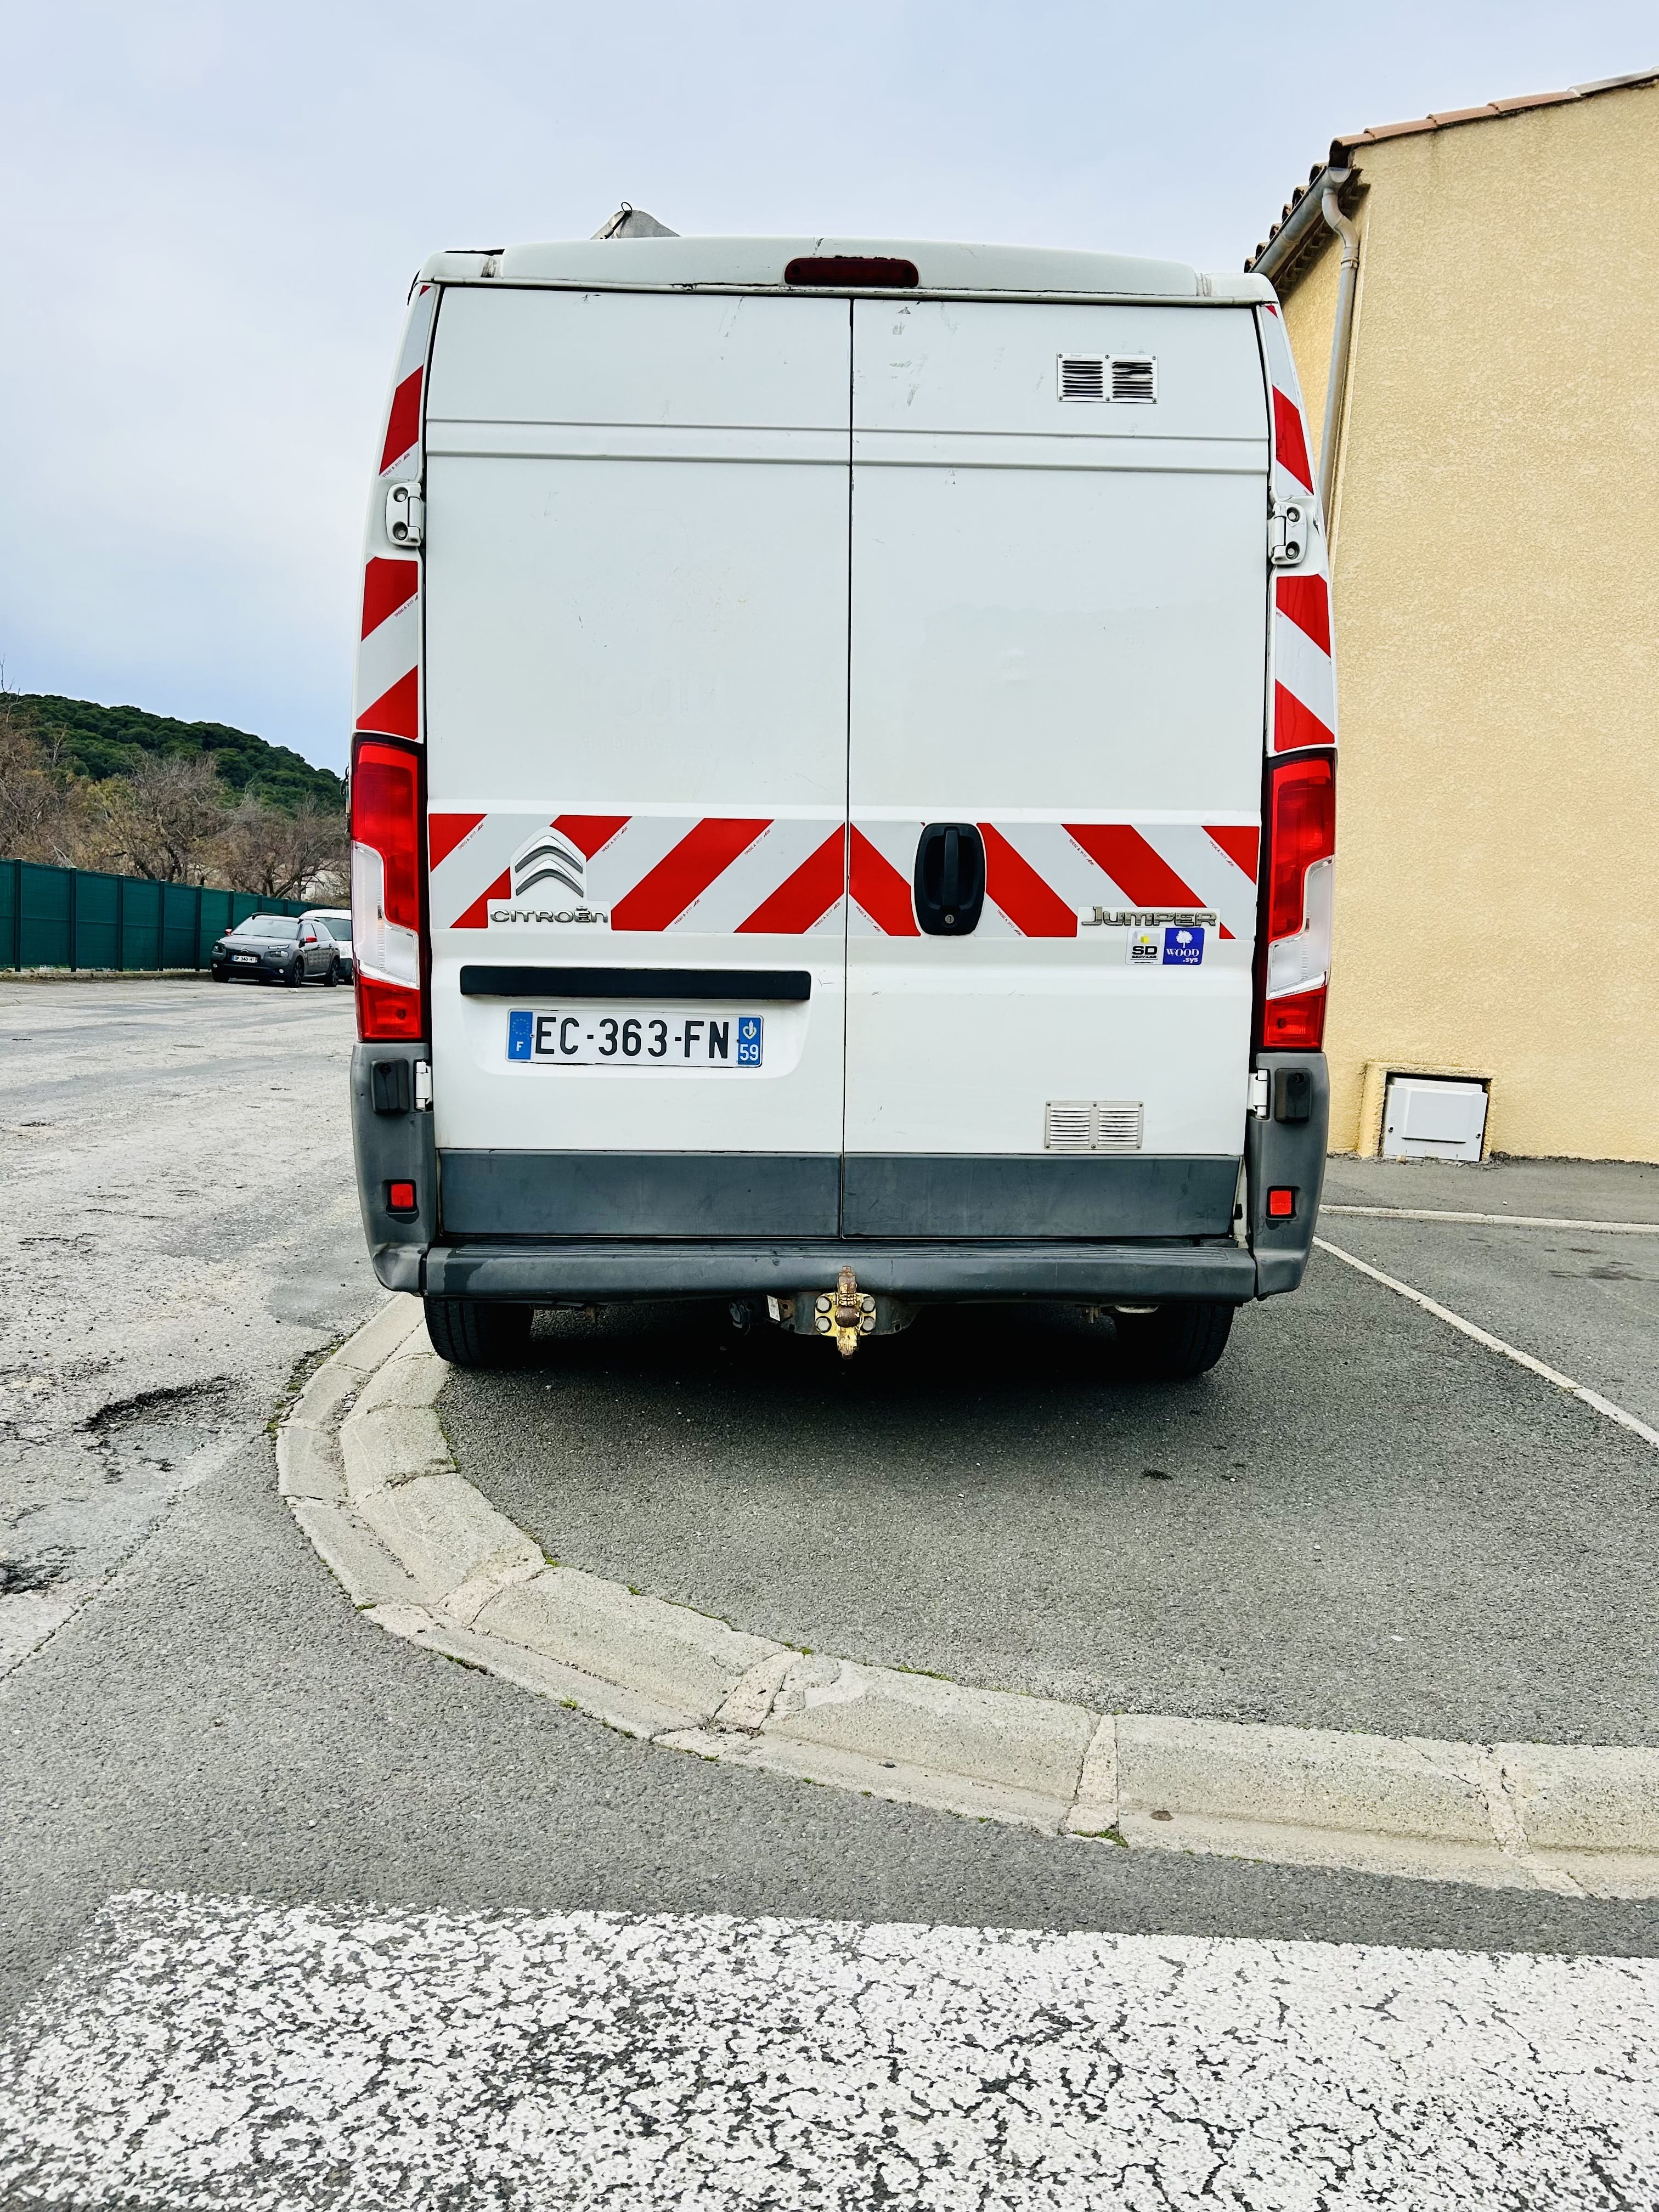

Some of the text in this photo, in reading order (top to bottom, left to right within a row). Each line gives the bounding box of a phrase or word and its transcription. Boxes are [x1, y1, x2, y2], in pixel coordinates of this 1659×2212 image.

[1132, 946, 1158, 955] SD
[1166, 949, 1199, 957] WOOD
[516, 1041, 523, 1051] F
[740, 1044, 759, 1061] 59
